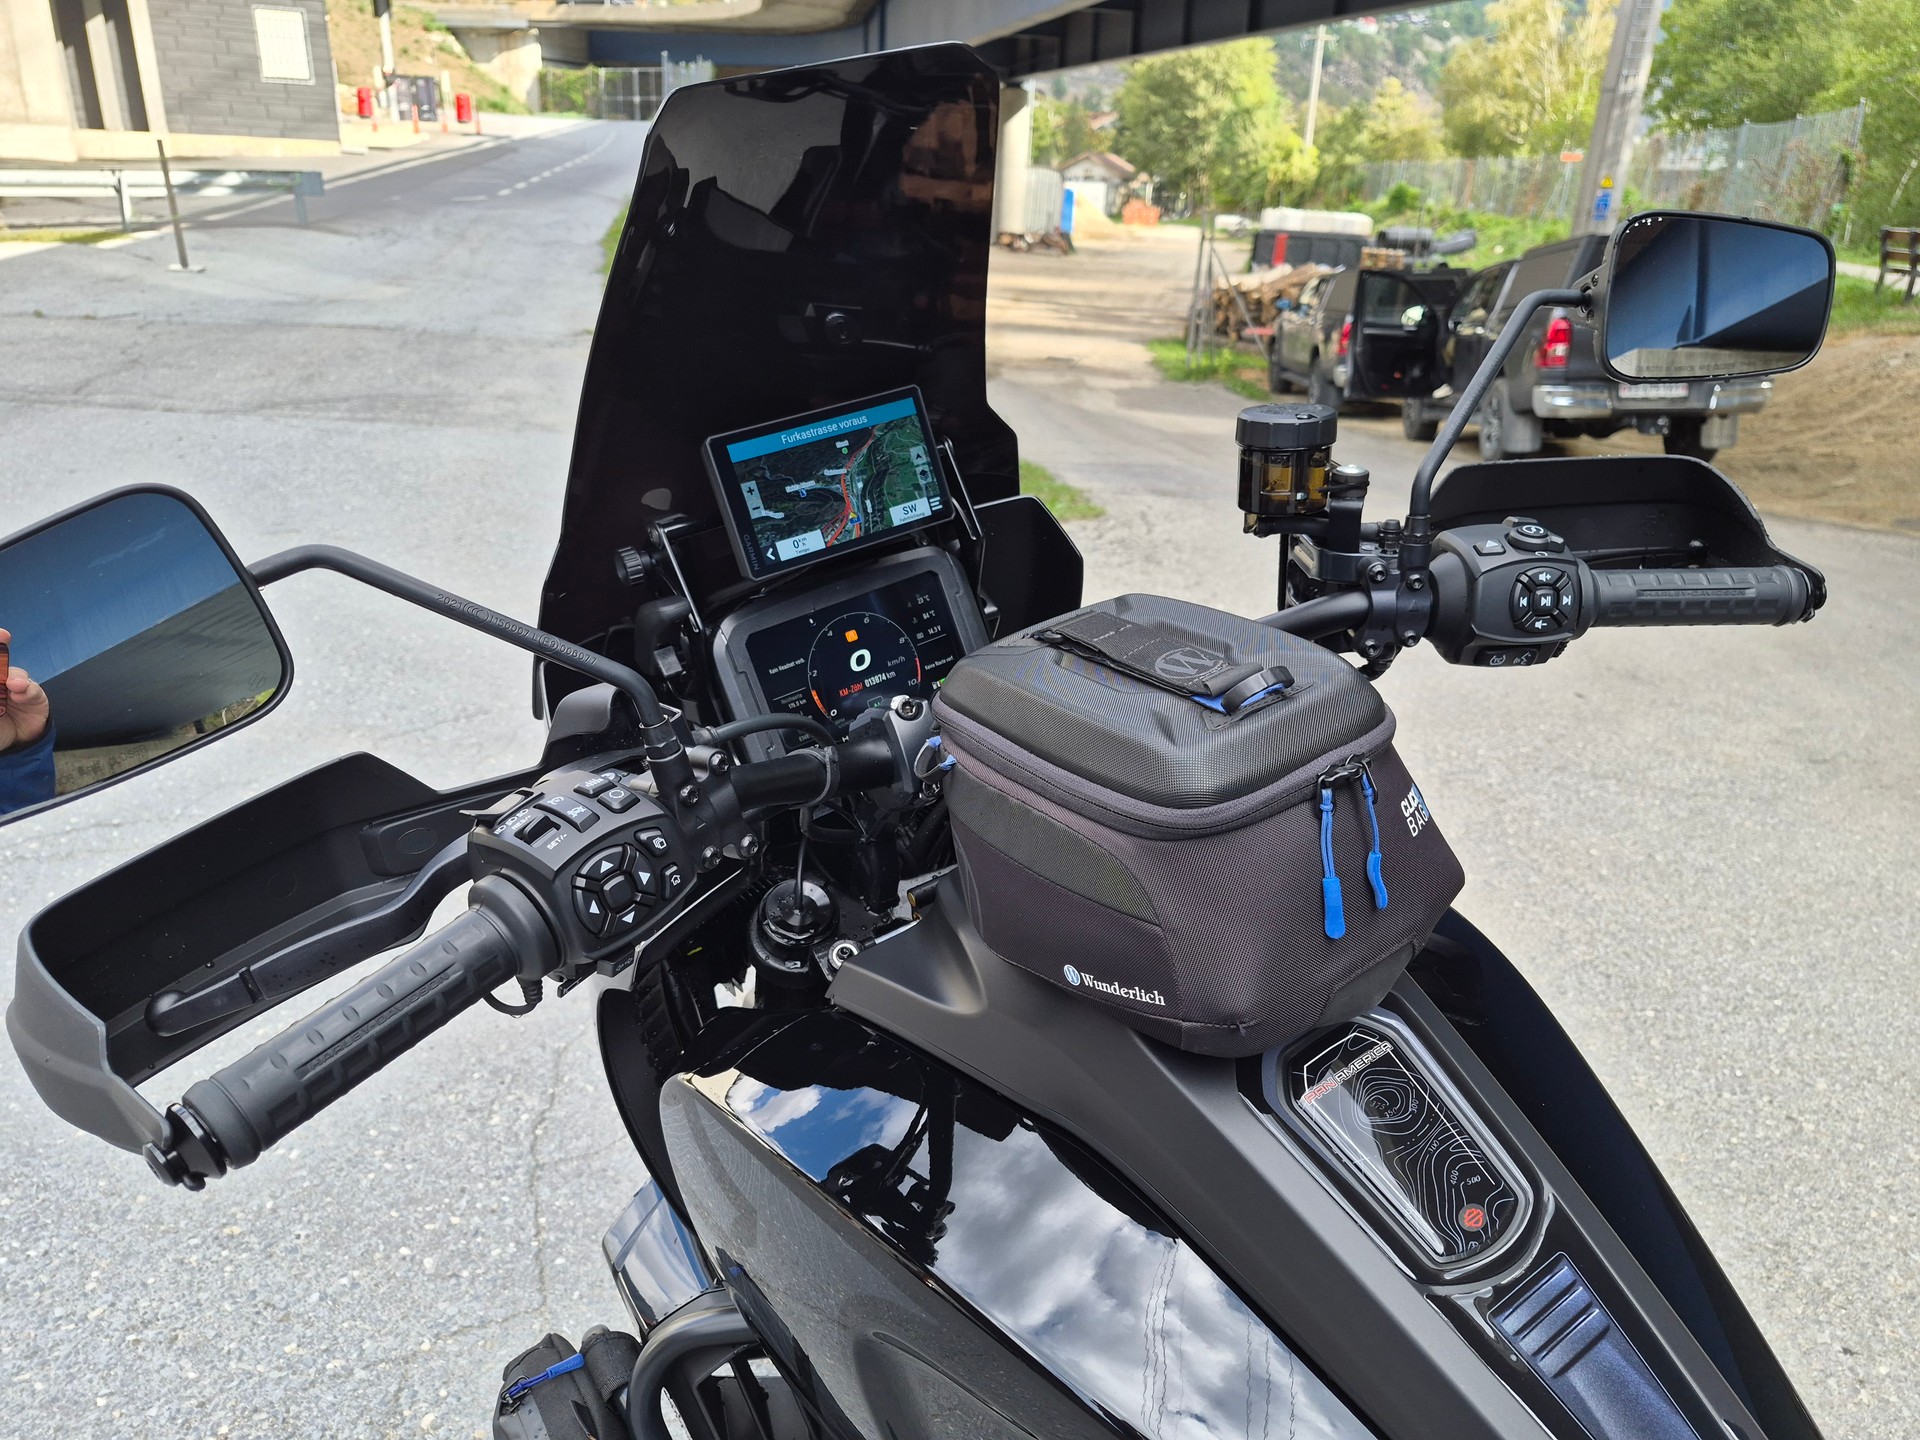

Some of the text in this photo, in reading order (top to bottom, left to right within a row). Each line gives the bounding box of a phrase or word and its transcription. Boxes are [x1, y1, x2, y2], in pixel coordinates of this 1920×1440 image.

[781, 416, 867, 444] Furkastrasse voraus
[902, 503, 917, 516] SW
[792, 539, 800, 549] 0
[744, 534, 760, 571] GARMIN
[436, 593, 463, 610] 2021
[849, 648, 872, 672] 0
[887, 655, 906, 668] km/h
[886, 670, 897, 680] km
[907, 679, 917, 687] 10
[830, 709, 838, 717] 0
[1407, 804, 1429, 838] BAG
[1081, 972, 1166, 1006] Wunderlich
[1302, 1040, 1394, 1106] PAN AMERICA
[1370, 1100, 1386, 1110] 375
[1384, 1106, 1398, 1119] 350
[1450, 1169, 1459, 1185] 400
[1466, 1175, 1481, 1186] 500
